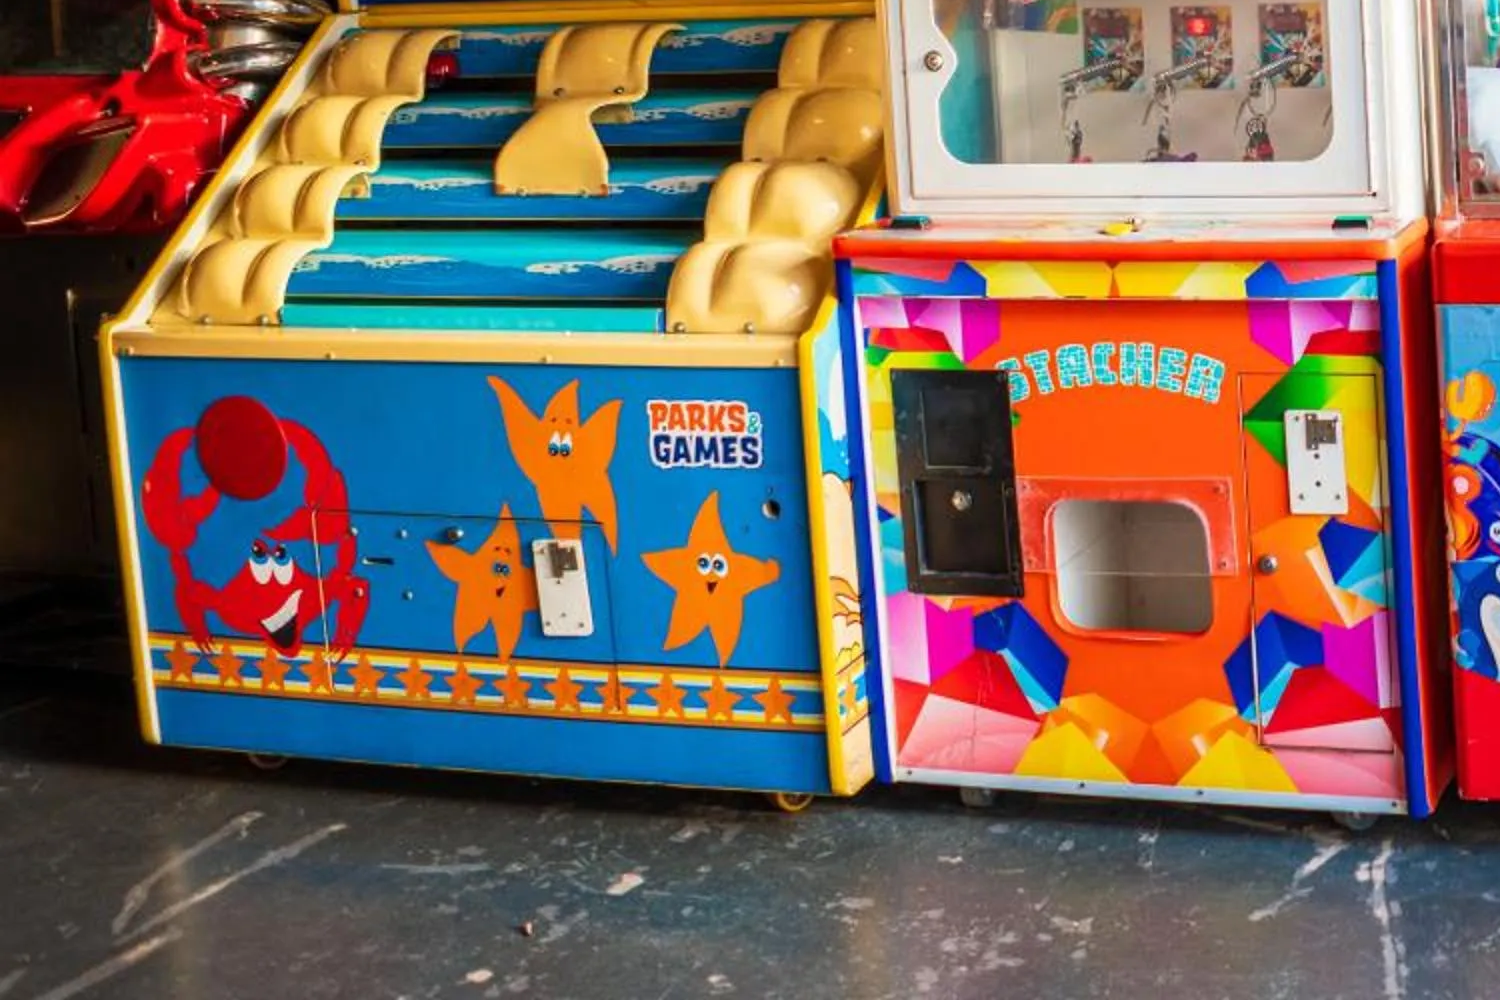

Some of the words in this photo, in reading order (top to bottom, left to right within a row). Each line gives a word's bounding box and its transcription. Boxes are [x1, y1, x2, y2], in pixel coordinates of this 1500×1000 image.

[649, 403, 745, 432] PARKS
[747, 413, 759, 434] &
[653, 434, 759, 464] GAMES
